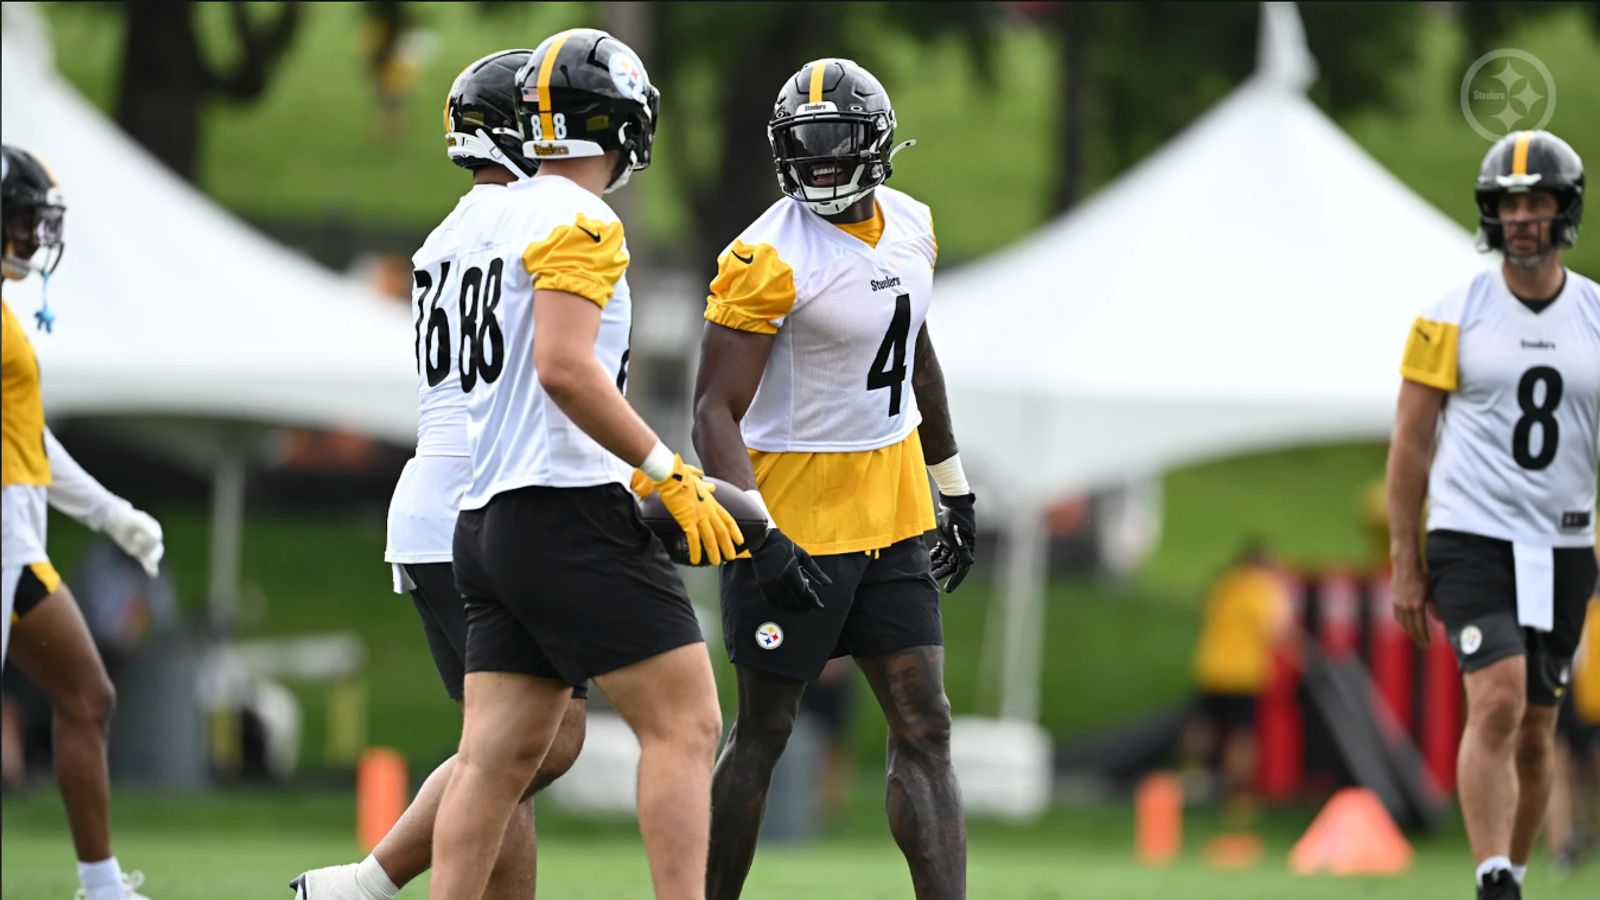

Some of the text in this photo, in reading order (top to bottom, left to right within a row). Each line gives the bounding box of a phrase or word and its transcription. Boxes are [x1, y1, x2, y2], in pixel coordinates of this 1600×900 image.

[804, 103, 826, 111] Steelers
[533, 143, 569, 156] Steelers
[870, 276, 901, 291] Steelers
[459, 257, 504, 393] 88
[867, 293, 911, 417] 4
[1512, 365, 1563, 471] 8
